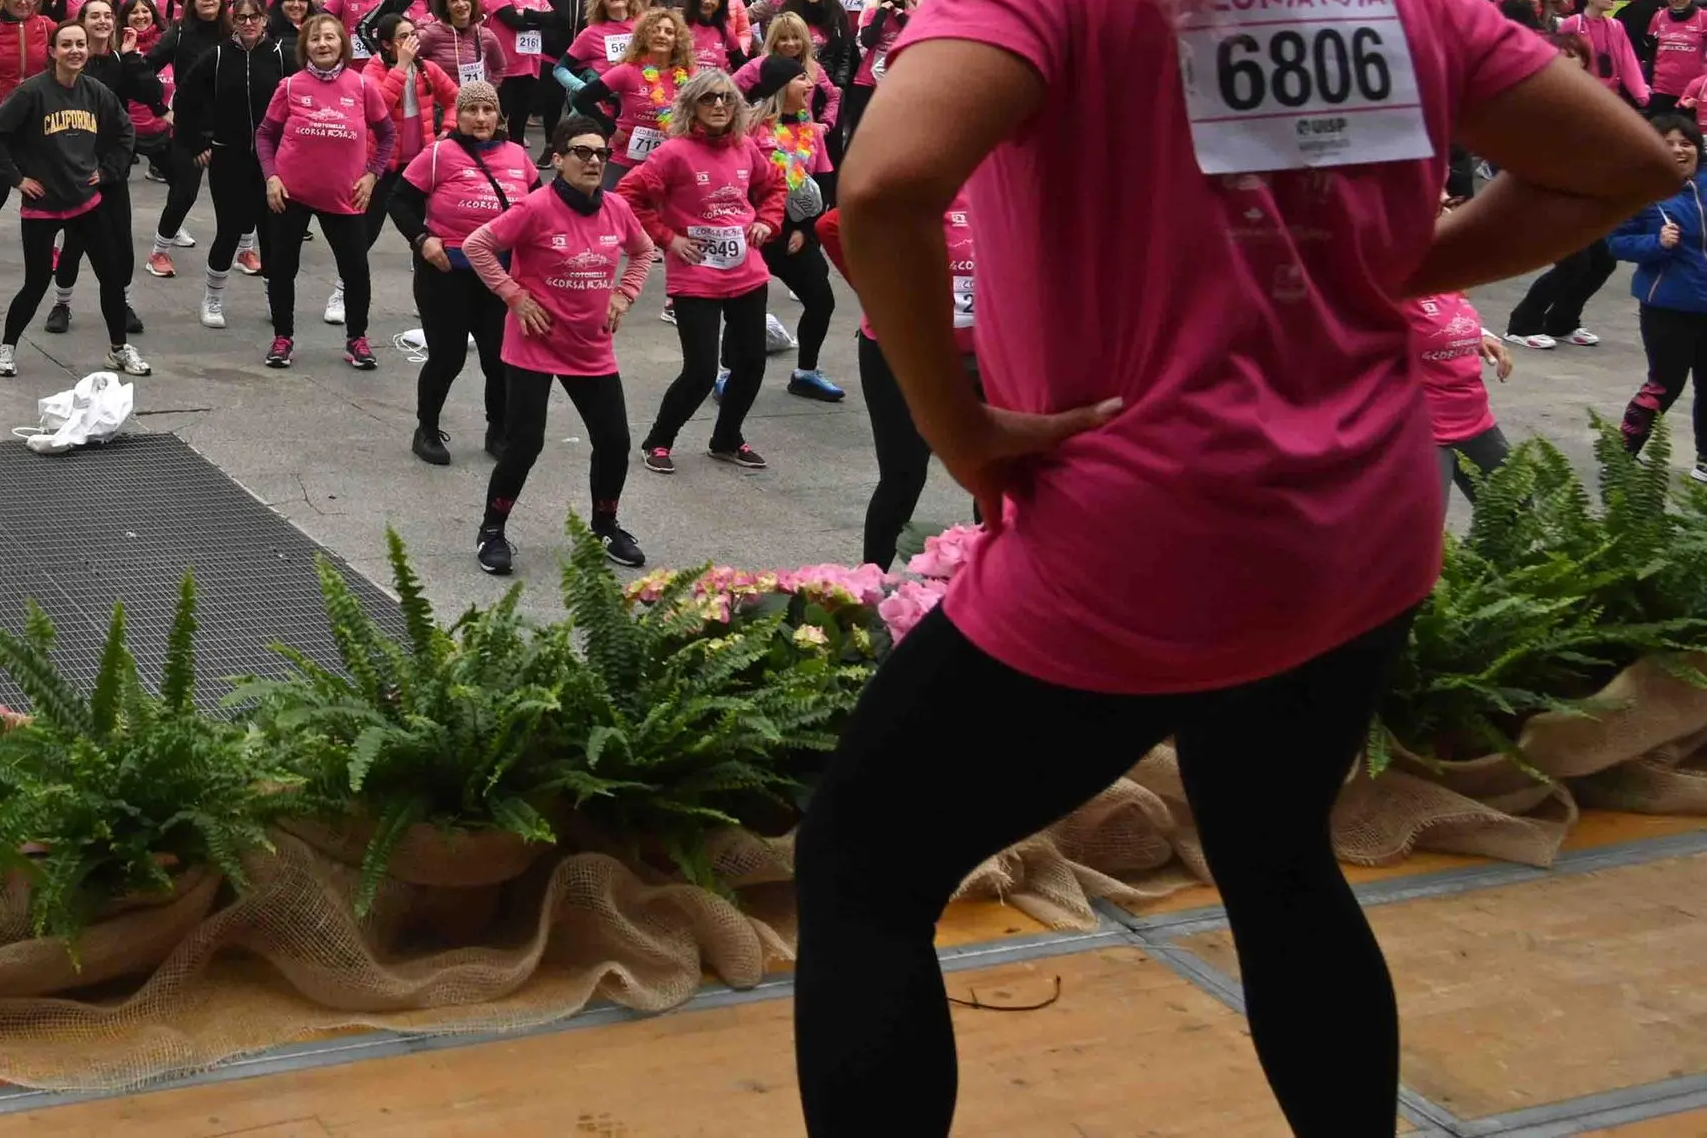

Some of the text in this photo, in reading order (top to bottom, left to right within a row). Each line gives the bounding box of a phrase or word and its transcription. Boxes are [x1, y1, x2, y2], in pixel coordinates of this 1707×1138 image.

[1217, 27, 1391, 111] 6806
[44, 109, 98, 136] CALIFORNIA
[300, 128, 326, 136] CORSA
[466, 201, 498, 210] CORSA
[696, 228, 721, 237] CORSA
[553, 278, 585, 290] CORSA
